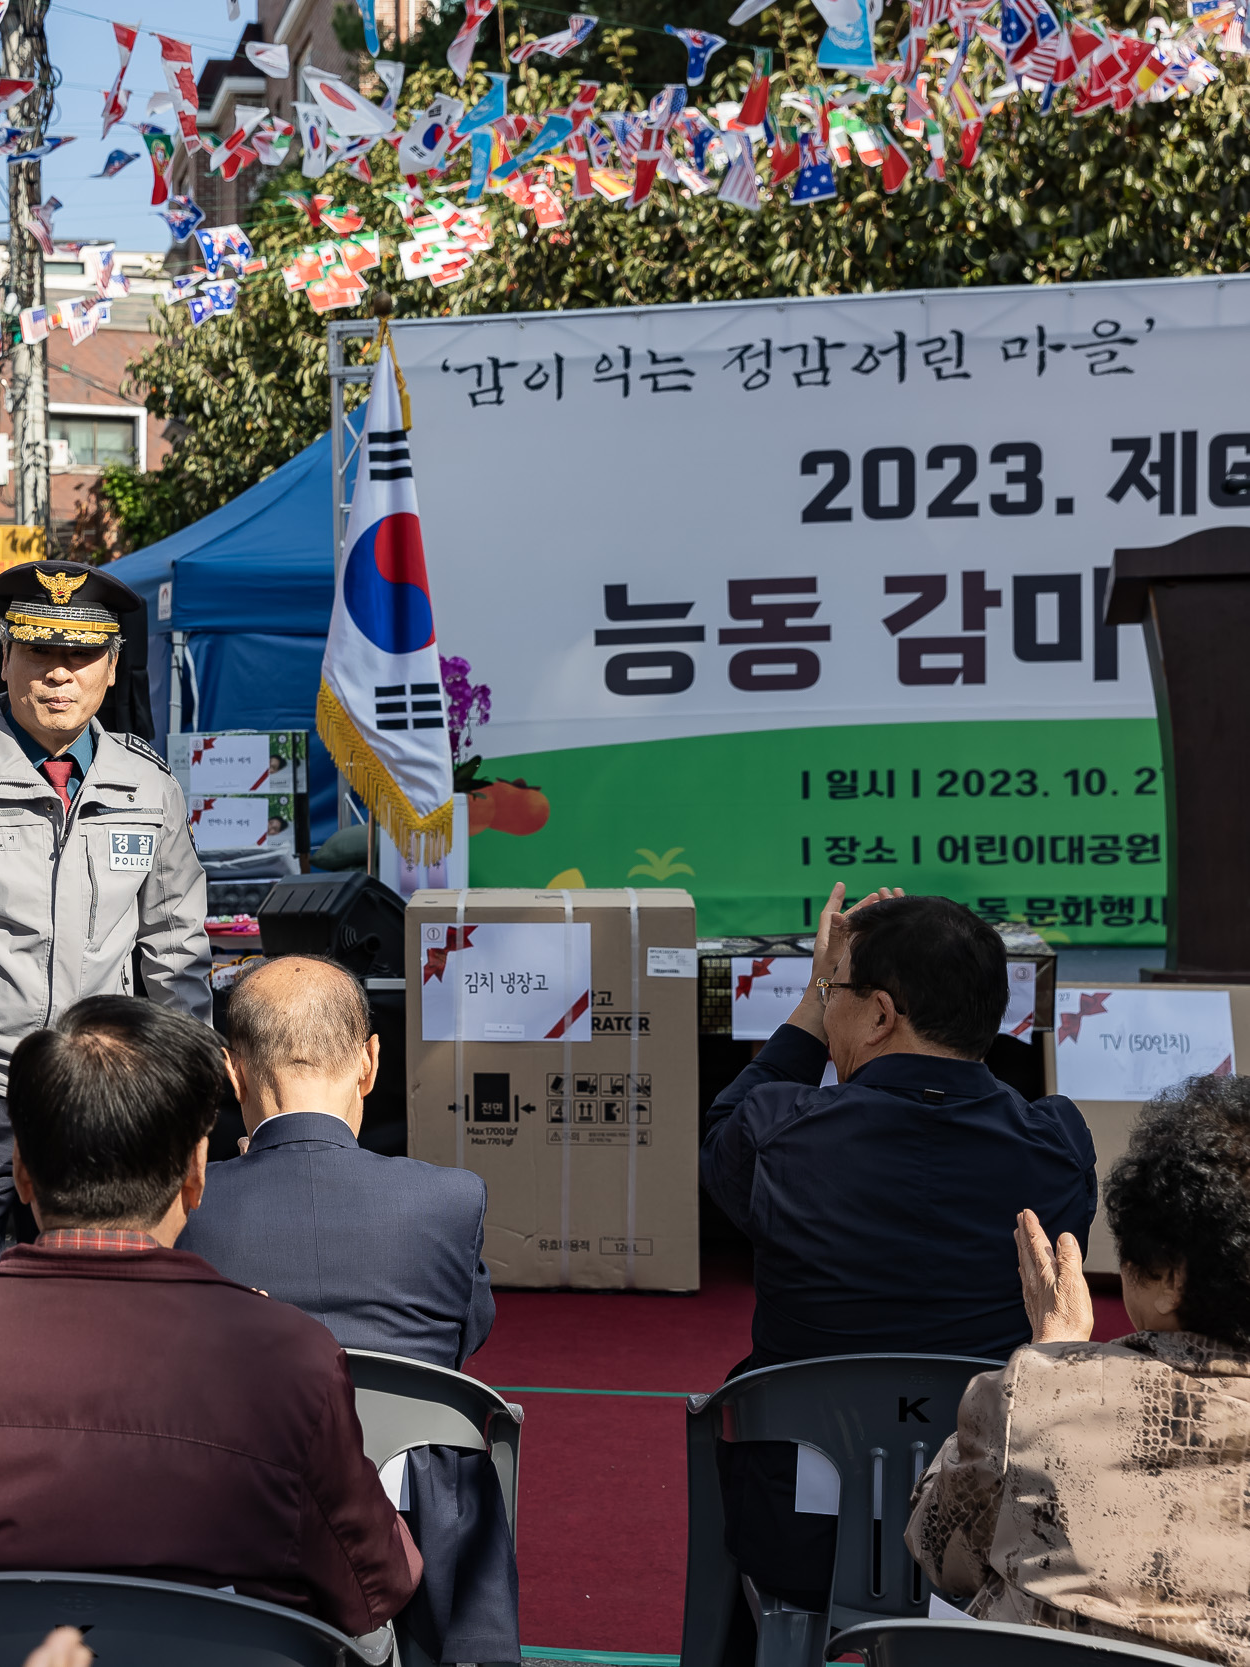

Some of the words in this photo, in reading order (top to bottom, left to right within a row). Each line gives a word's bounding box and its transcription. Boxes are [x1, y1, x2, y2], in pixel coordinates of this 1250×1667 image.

[594, 345, 695, 398] 익는
[723, 328, 971, 391] 정감어린
[800, 441, 1074, 523] 2023.
[594, 576, 831, 696] 능동
[937, 769, 1049, 798] 2023.
[1063, 768, 1119, 797] 10.
[1134, 767, 1164, 796] 2
[114, 834, 152, 854] 경찰
[937, 834, 1162, 866] 어린이대공원
[115, 857, 150, 867] POLICE
[464, 972, 493, 994] 김치
[500, 972, 548, 994] 냉장고
[1099, 1034, 1122, 1050] TV
[1128, 1033, 1190, 1055] (50인치)
[481, 1102, 503, 1115] 전면
[467, 1127, 484, 1136] Max
[485, 1127, 505, 1136] 1700
[471, 1137, 487, 1145] Max
[487, 1137, 500, 1145] 770
[898, 1397, 931, 1423] K
